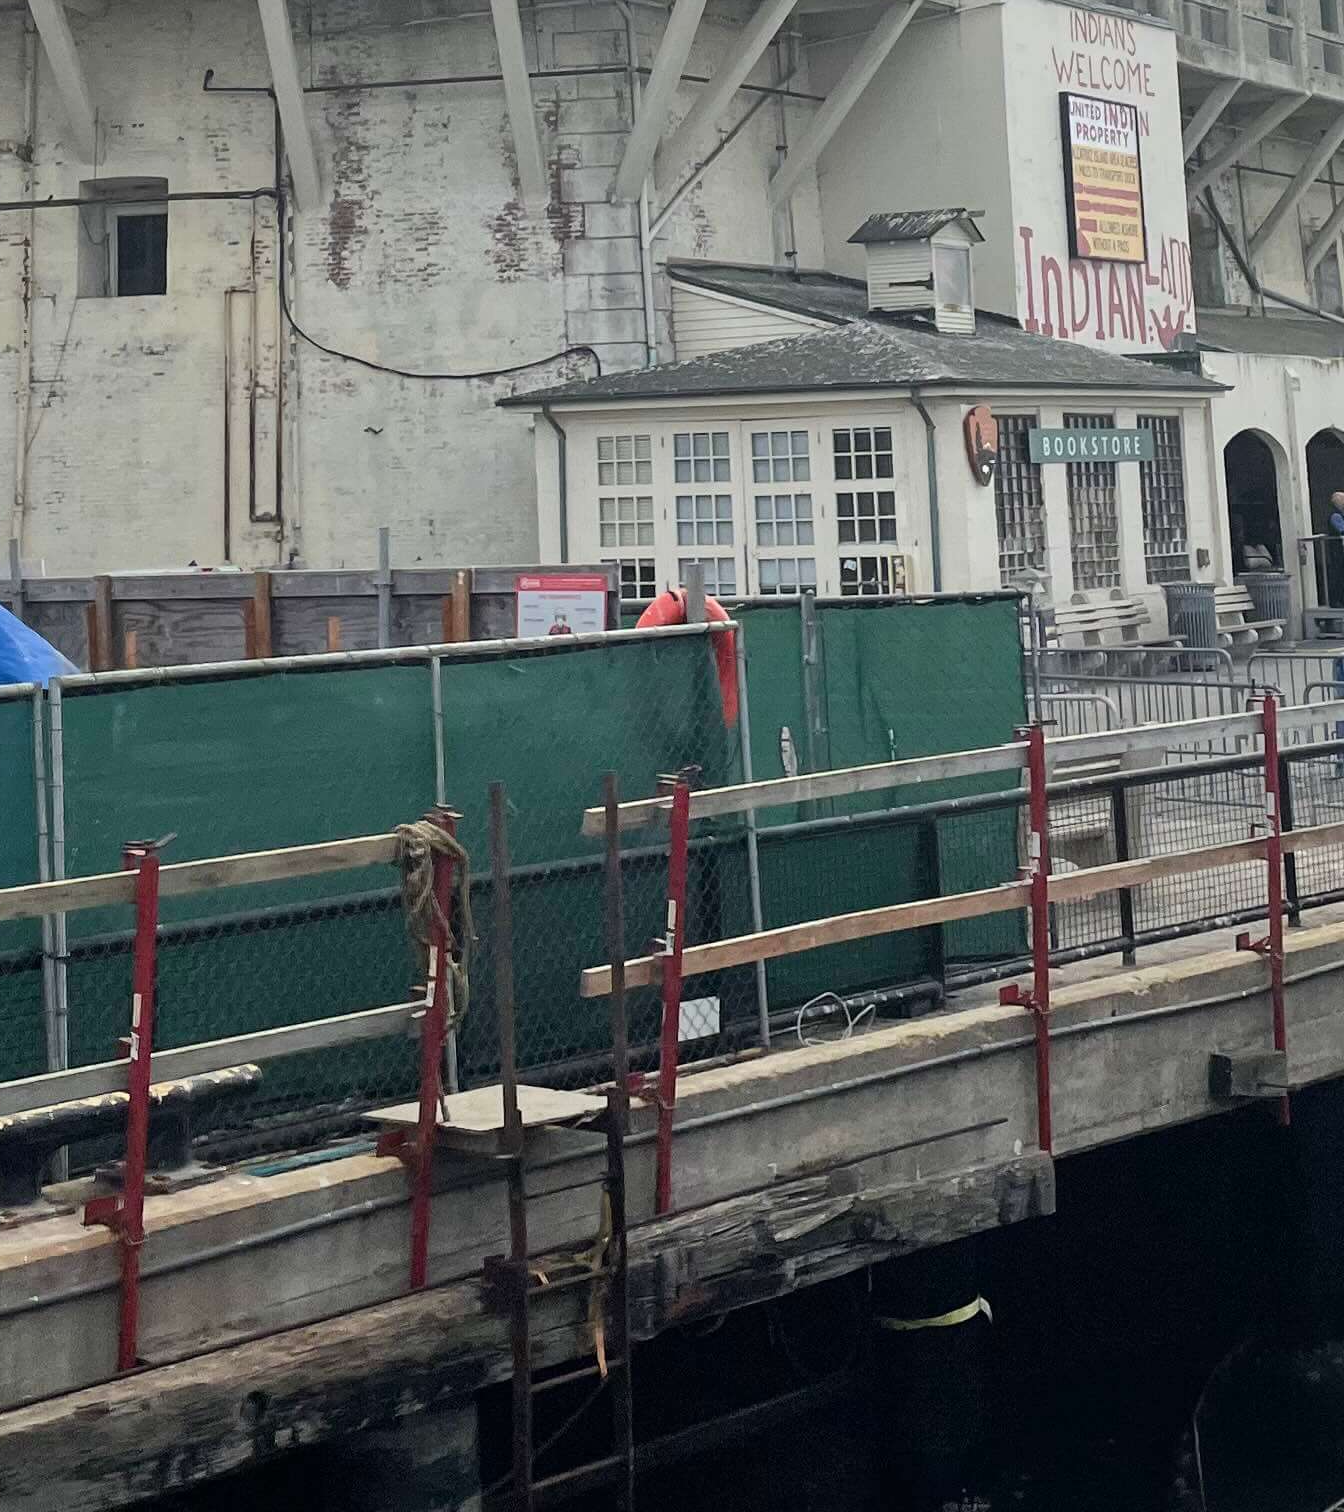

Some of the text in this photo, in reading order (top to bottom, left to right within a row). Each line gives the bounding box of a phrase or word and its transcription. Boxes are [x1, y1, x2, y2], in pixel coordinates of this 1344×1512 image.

[1070, 10, 1136, 57] INDIANS
[1051, 45, 1155, 96] WELCOME
[1076, 122, 1129, 148] PROPERTY
[1043, 436, 1141, 456] BOOKSTORE
